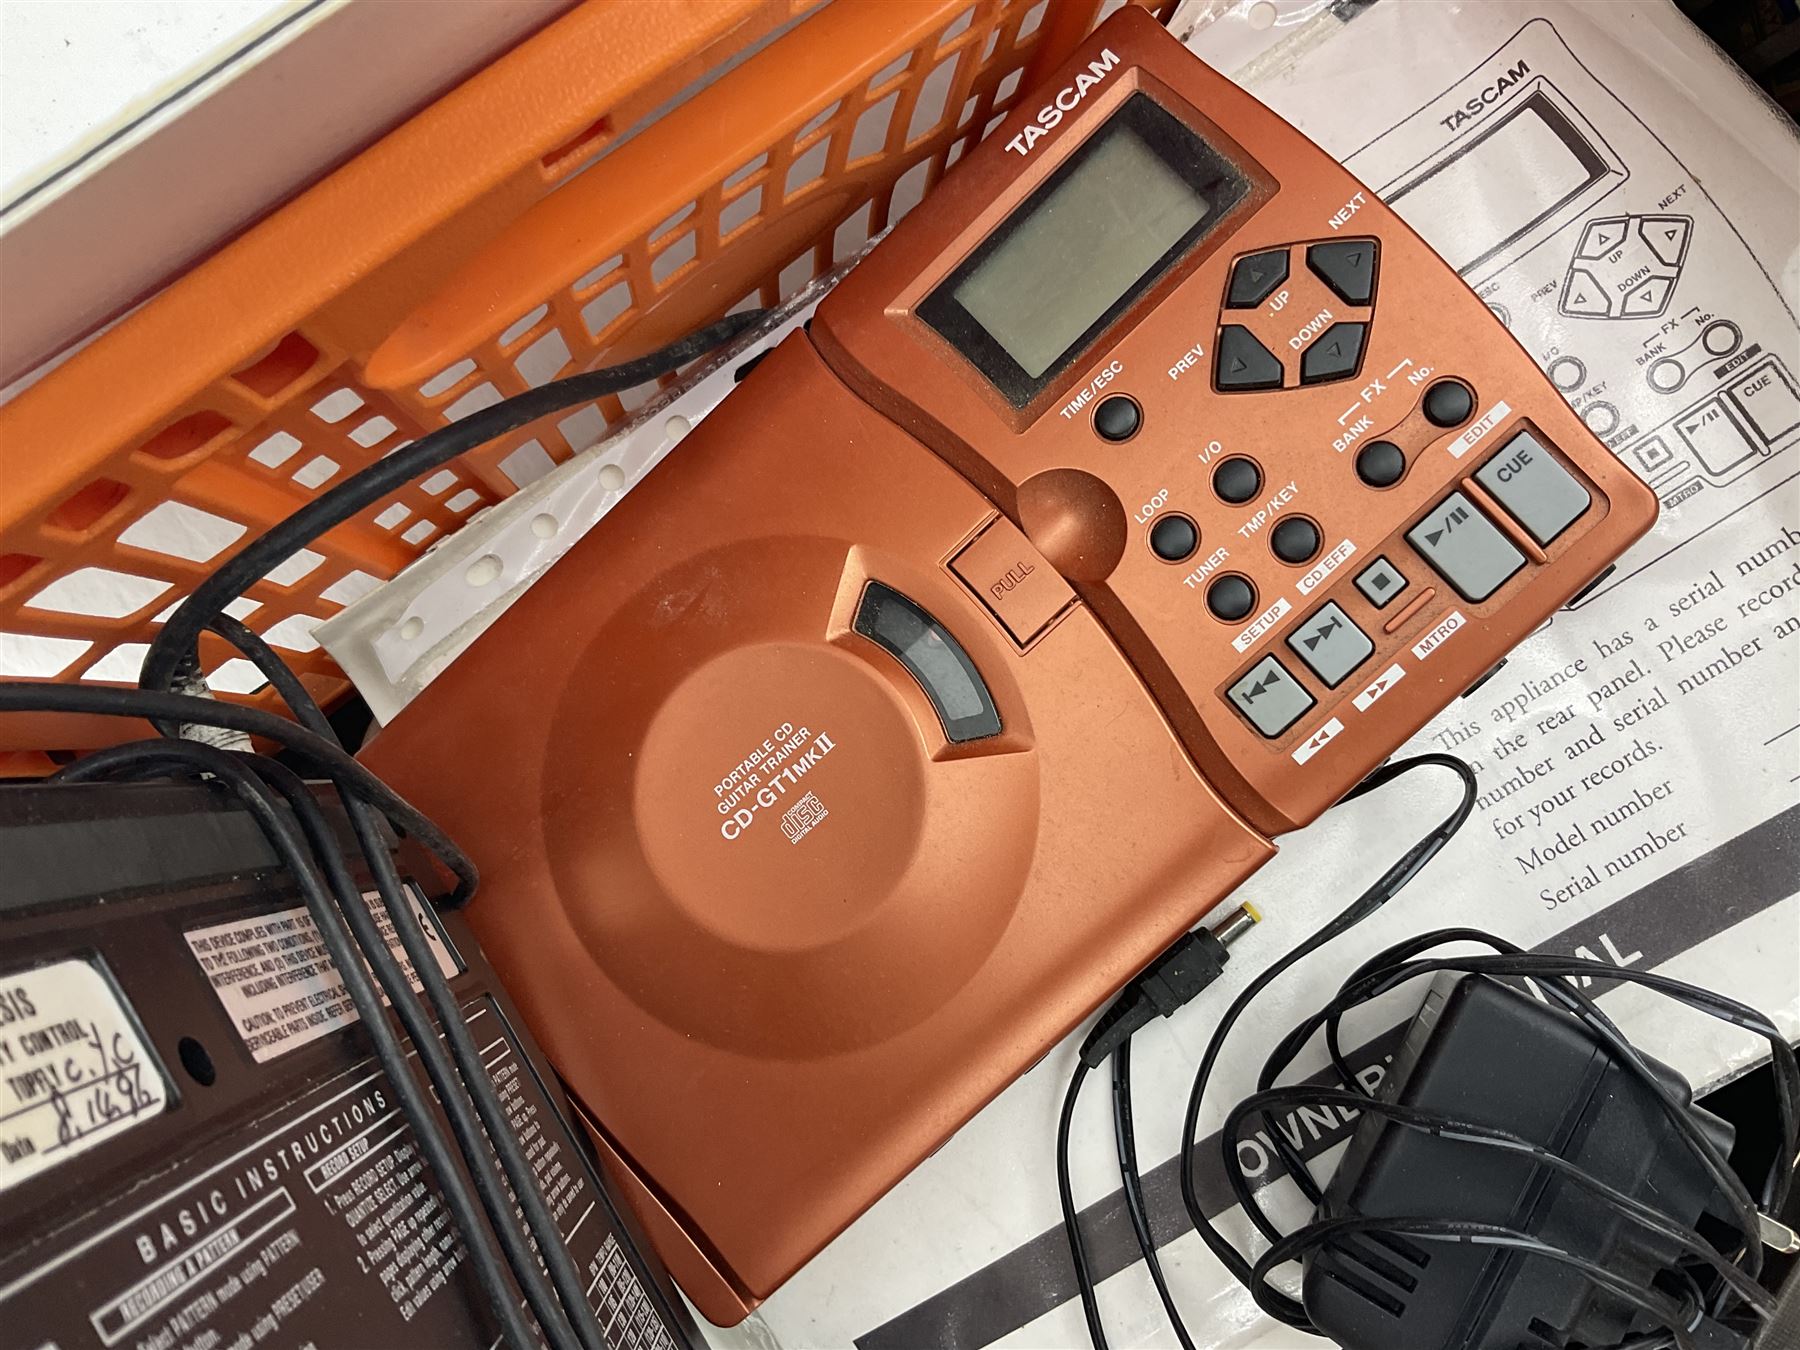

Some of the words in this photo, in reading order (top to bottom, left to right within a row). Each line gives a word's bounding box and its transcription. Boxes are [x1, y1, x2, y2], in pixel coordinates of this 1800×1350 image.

[1004, 48, 1121, 157] TASCAM
[1439, 59, 1531, 133] TASCAM
[1328, 191, 1368, 230] NEXT
[1657, 184, 1687, 211] NEXT
[1608, 250, 1624, 264] UP
[1530, 280, 1559, 302] PREV
[1617, 265, 1651, 293] DOWN
[1272, 290, 1290, 312] UP
[1695, 312, 1715, 327] No.
[1288, 309, 1334, 351] DOWN
[1660, 319, 1680, 336] FX
[1167, 344, 1204, 381] PREV
[1635, 342, 1667, 366] BANK
[1726, 352, 1750, 373] EDIT
[1059, 360, 1123, 420] TIME/ESC
[1360, 379, 1387, 403] FX
[1407, 366, 1434, 386] No.
[1744, 375, 1772, 397] CUE
[1332, 414, 1374, 453] BANK
[1463, 414, 1495, 446] EDIT
[1198, 441, 1222, 464] I/O
[1497, 450, 1533, 483] CUE
[1134, 488, 1170, 524] LOOP
[1237, 480, 1300, 540] TMP/KEY
[990, 561, 1035, 600] PULL
[1183, 547, 1230, 591] TUNER
[1303, 569, 1324, 590] CD
[1323, 545, 1351, 570] EFF
[1240, 606, 1281, 646] SETUP
[1418, 618, 1458, 655] MTRO
[1433, 720, 1481, 751] This
[1490, 658, 1588, 723] appliance
[1593, 631, 1634, 660] has
[1643, 617, 1660, 632] a
[1669, 570, 1726, 617] serial
[1492, 733, 1528, 760] the
[1536, 704, 1577, 735] rear
[1586, 659, 1652, 712] panel.
[1656, 616, 1728, 663] Please
[1476, 757, 1556, 812] number
[1564, 723, 1606, 760] and
[1613, 686, 1671, 732] serial
[1677, 636, 1764, 696] number
[714, 739, 776, 798] PORTABLE
[774, 722, 793, 742] CD
[717, 773, 761, 815] GUITAR
[759, 727, 811, 774] TRAINER
[1492, 814, 1526, 840] for
[1527, 785, 1577, 827] your
[1580, 739, 1664, 792] records.
[791, 825, 813, 844] DIGITAL
[811, 809, 829, 827] AUDIO
[1514, 823, 1589, 875] Model
[1590, 780, 1675, 835] number
[1539, 865, 1602, 910] Serial
[1603, 822, 1689, 877] number
[209, 932, 235, 949] DEVICE
[233, 926, 267, 944] COMPLIES
[226, 944, 266, 964] FOLLOWING
[281, 998, 311, 1018] PREVENT
[18, 1018, 89, 1056] CONTROL
[135, 1190, 228, 1264] BASIC
[234, 1090, 386, 1200] INSTRUCTIONS
[320, 1150, 350, 1180] RECORD
[348, 1137, 369, 1161] SETUP
[333, 1189, 356, 1209] Press
[351, 1168, 379, 1195] RECORD
[345, 1195, 378, 1228] QUANTIZE
[395, 1171, 410, 1186] Use
[365, 1216, 385, 1241] select
[381, 1193, 414, 1227] quantization
[366, 1237, 397, 1266] Pressing
[390, 1220, 410, 1243] PAGE
[380, 1261, 400, 1288] pages
[396, 1236, 426, 1268] displaying
[118, 1264, 189, 1324] RECORDING
[184, 1258, 199, 1280] A
[196, 1228, 241, 1271] PATTERN
[170, 1291, 219, 1338] PATTERN
[215, 1275, 243, 1304] mode
[239, 1259, 267, 1286] using
[259, 1228, 301, 1267] PATTERN
[405, 1263, 427, 1291] pattern
[399, 1300, 417, 1322] Edit
[412, 1285, 433, 1308] values
[251, 1313, 280, 1343] using
